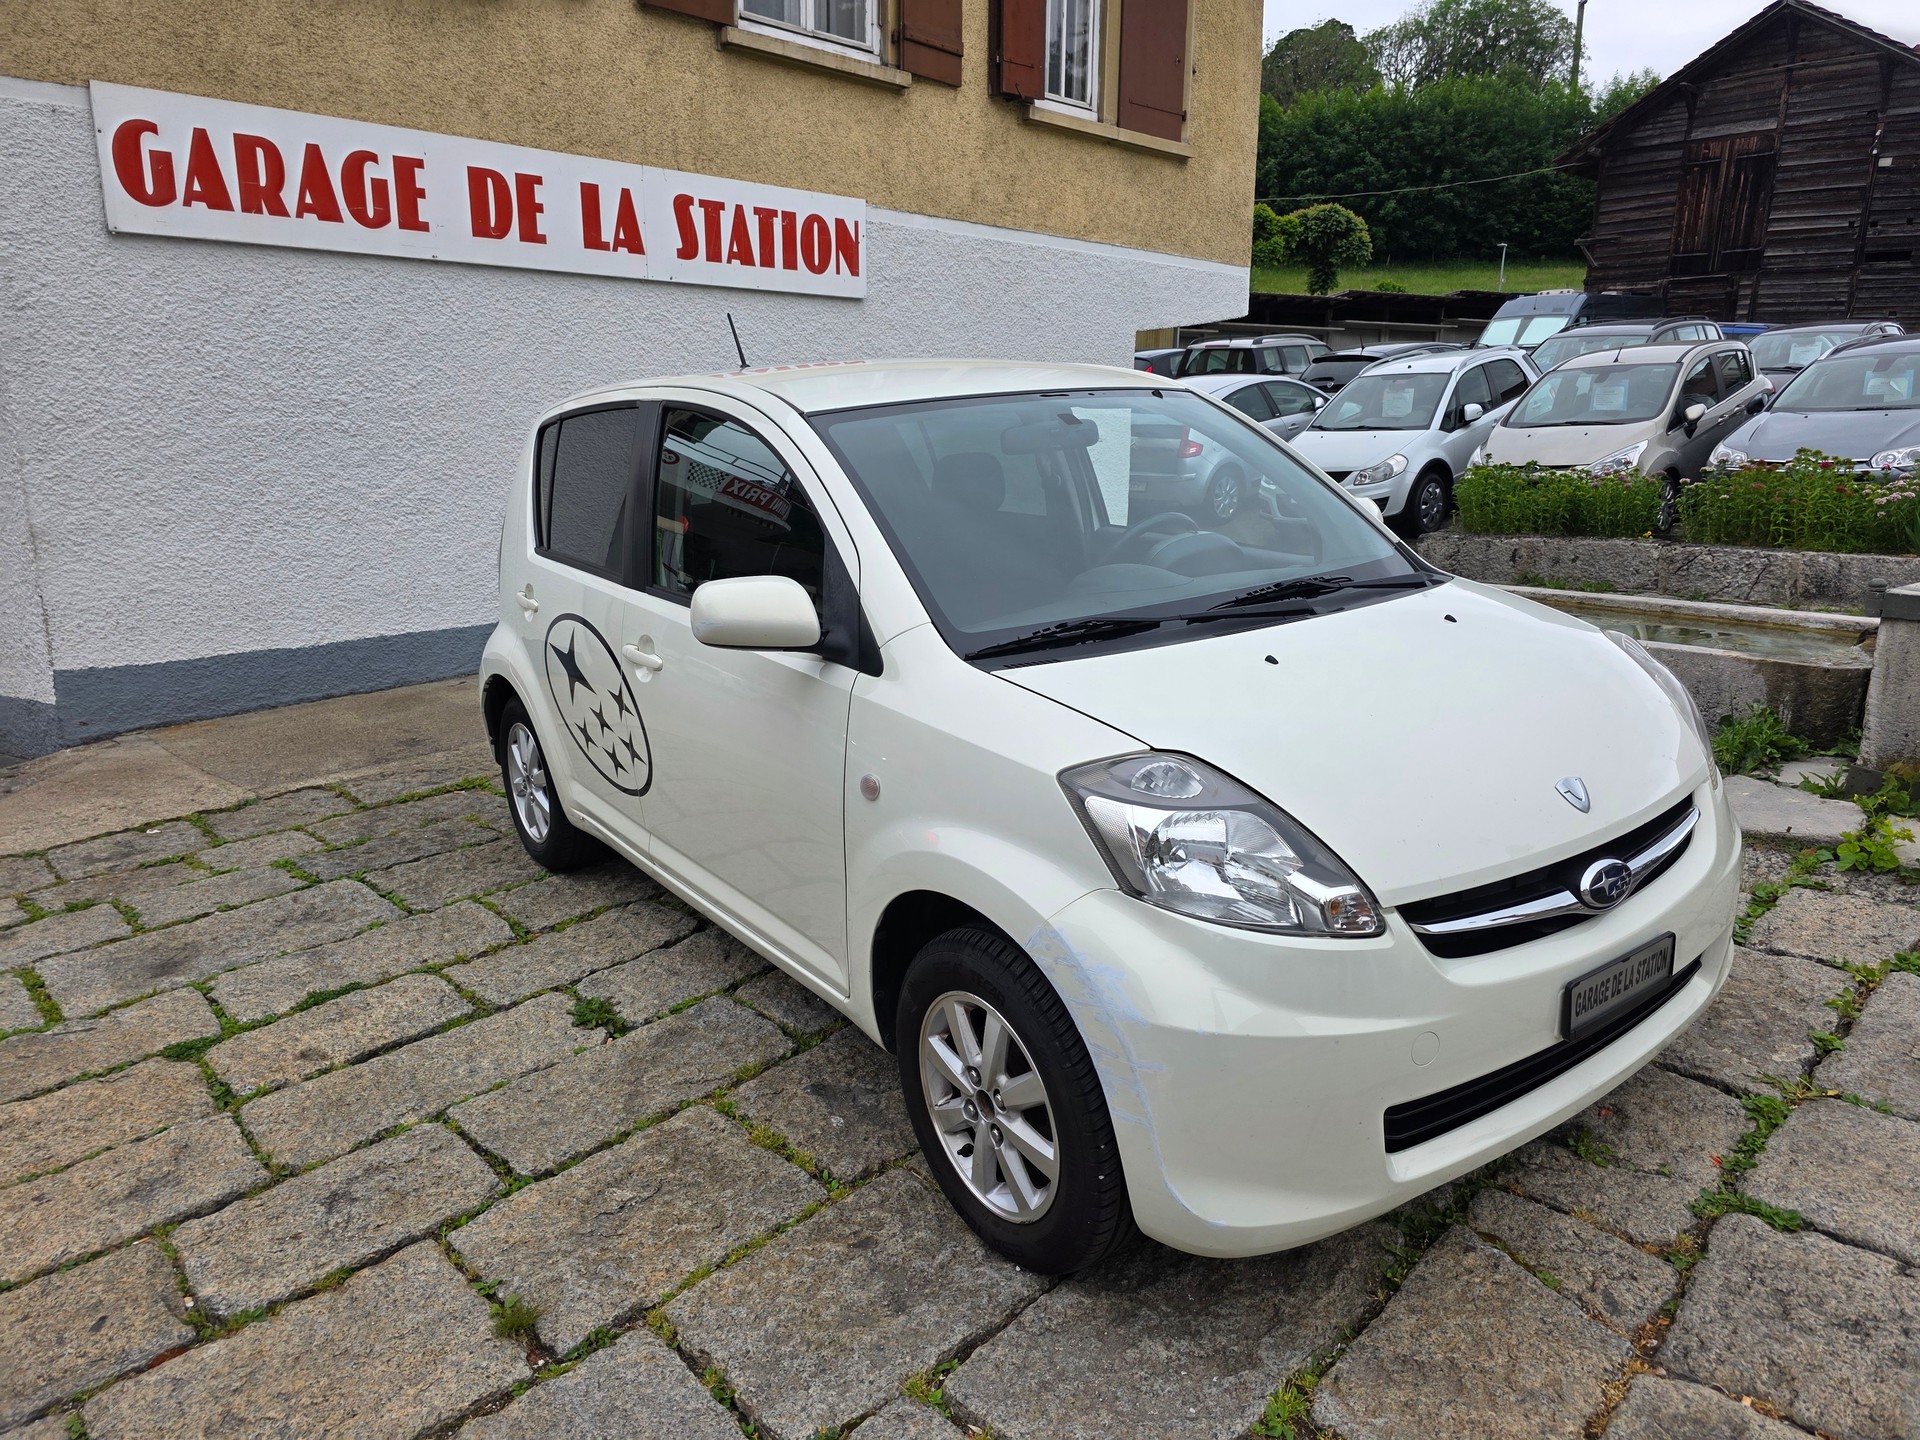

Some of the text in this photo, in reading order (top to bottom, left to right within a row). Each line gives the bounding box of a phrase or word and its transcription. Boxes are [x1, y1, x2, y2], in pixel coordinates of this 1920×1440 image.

[112, 119, 861, 277] GARAGE DE LA STATION
[1575, 947, 1669, 1017] GARAGE DE LA STATION
